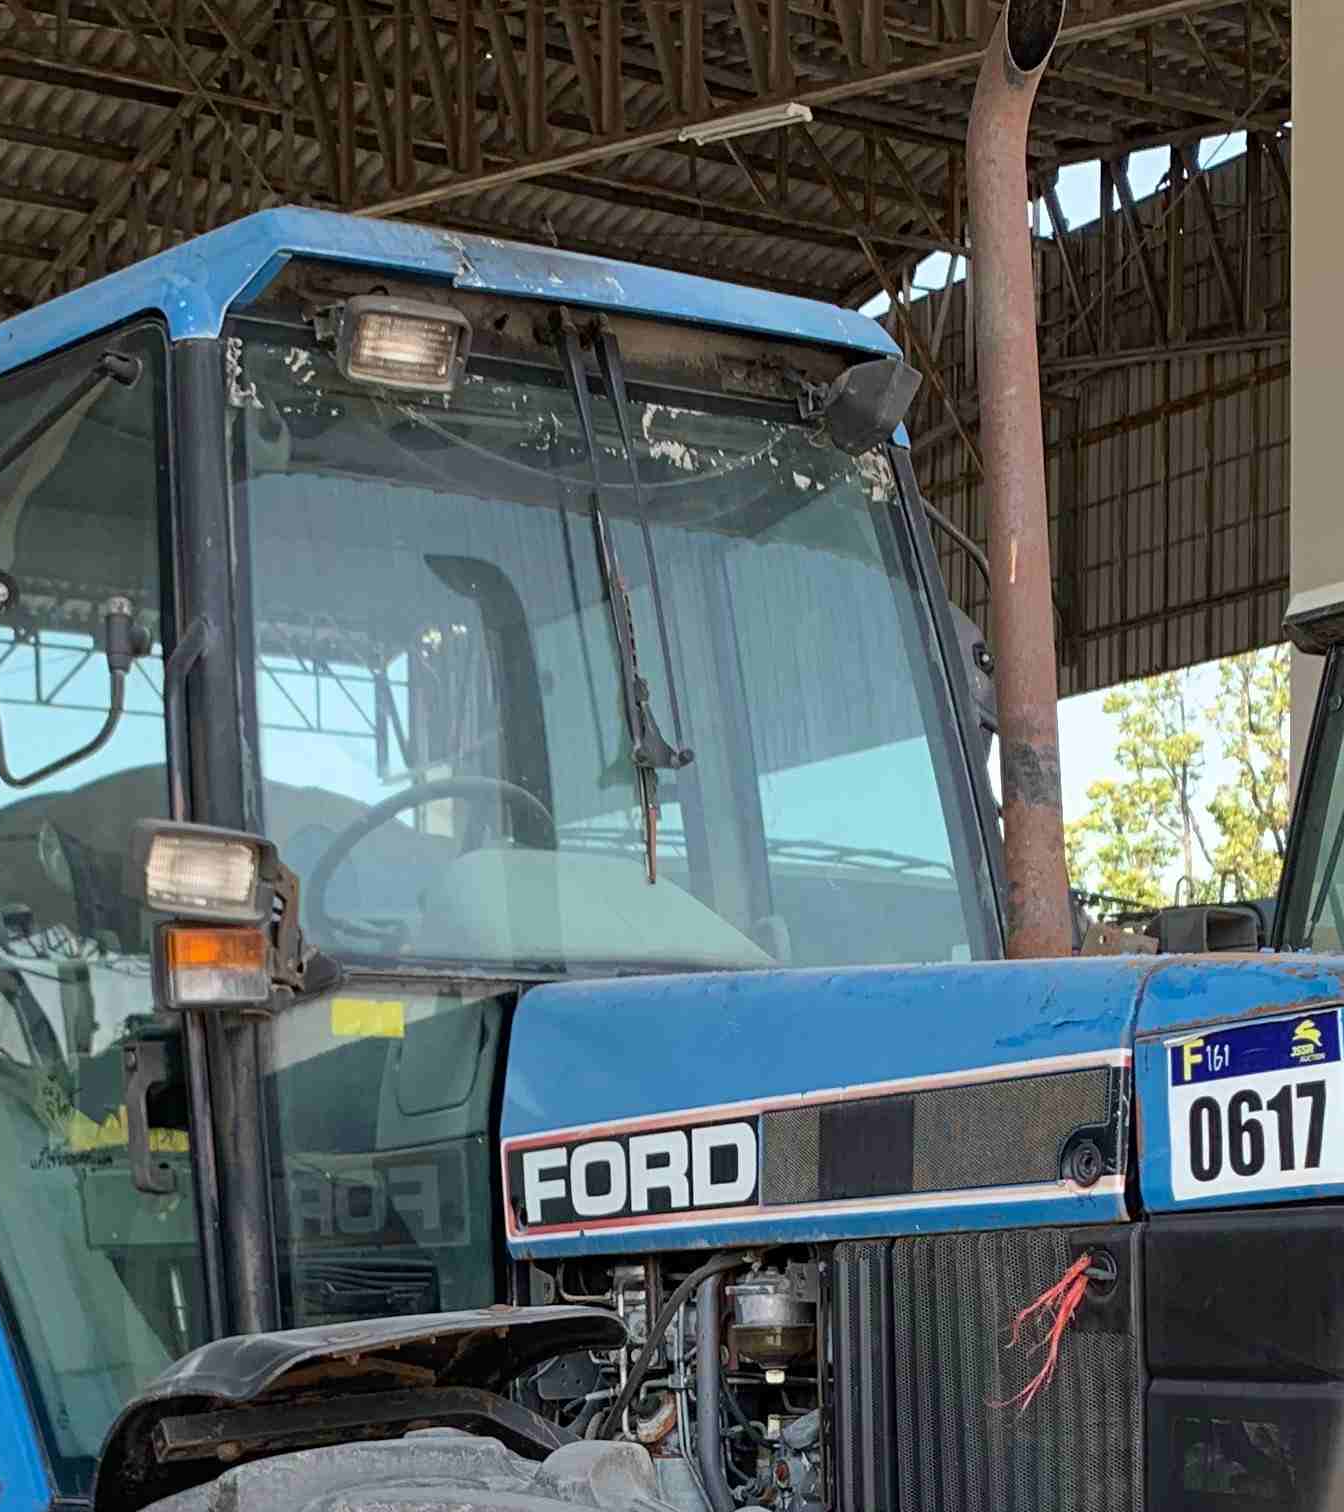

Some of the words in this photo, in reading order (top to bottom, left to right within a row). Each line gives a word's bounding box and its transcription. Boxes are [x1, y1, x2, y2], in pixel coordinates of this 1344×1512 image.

[1181, 1038, 1204, 1081] F
[1206, 1044, 1230, 1071] 161
[521, 1119, 758, 1225] FORD
[1189, 1079, 1328, 1183] 0617
